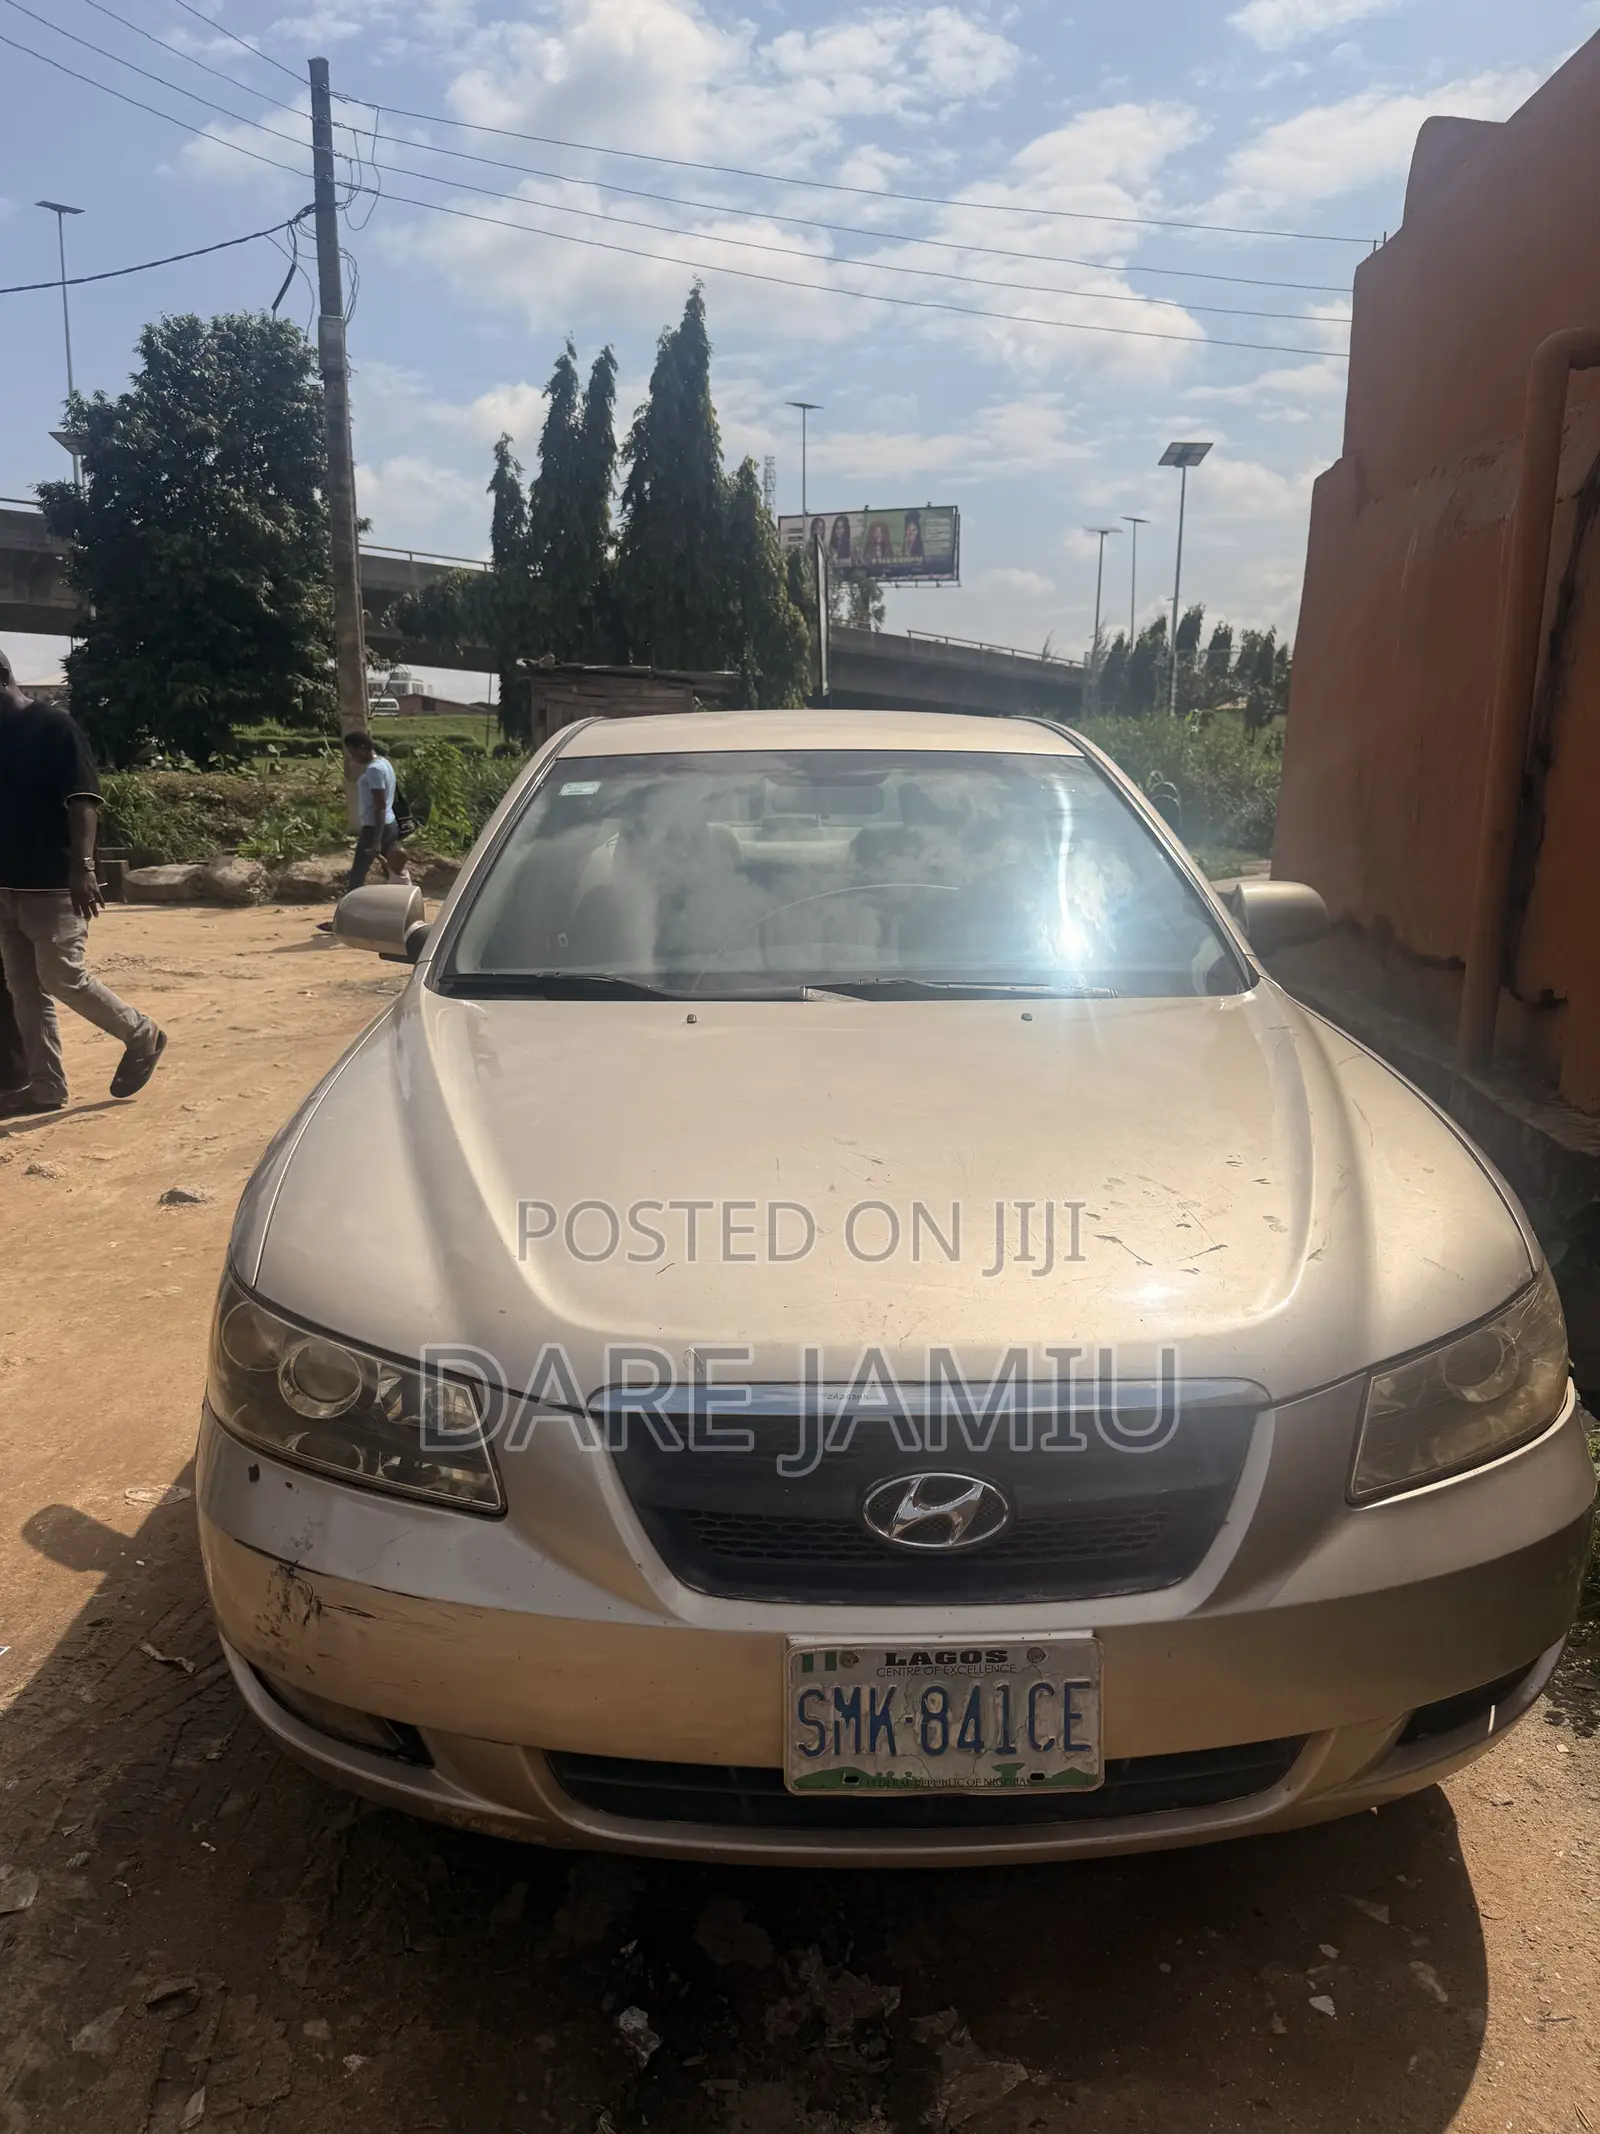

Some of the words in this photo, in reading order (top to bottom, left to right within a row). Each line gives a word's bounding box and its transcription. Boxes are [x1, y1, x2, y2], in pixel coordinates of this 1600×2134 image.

[884, 1649, 1009, 1667] LAGOS
[876, 1666, 921, 1677] CENTRE
[923, 1665, 941, 1676] OF
[943, 1663, 1017, 1676] EXCELLENCE
[914, 1777, 964, 1788] REPUBLIC
[966, 1776, 981, 1788] OF
[983, 1775, 1028, 1787] NIGERIA
